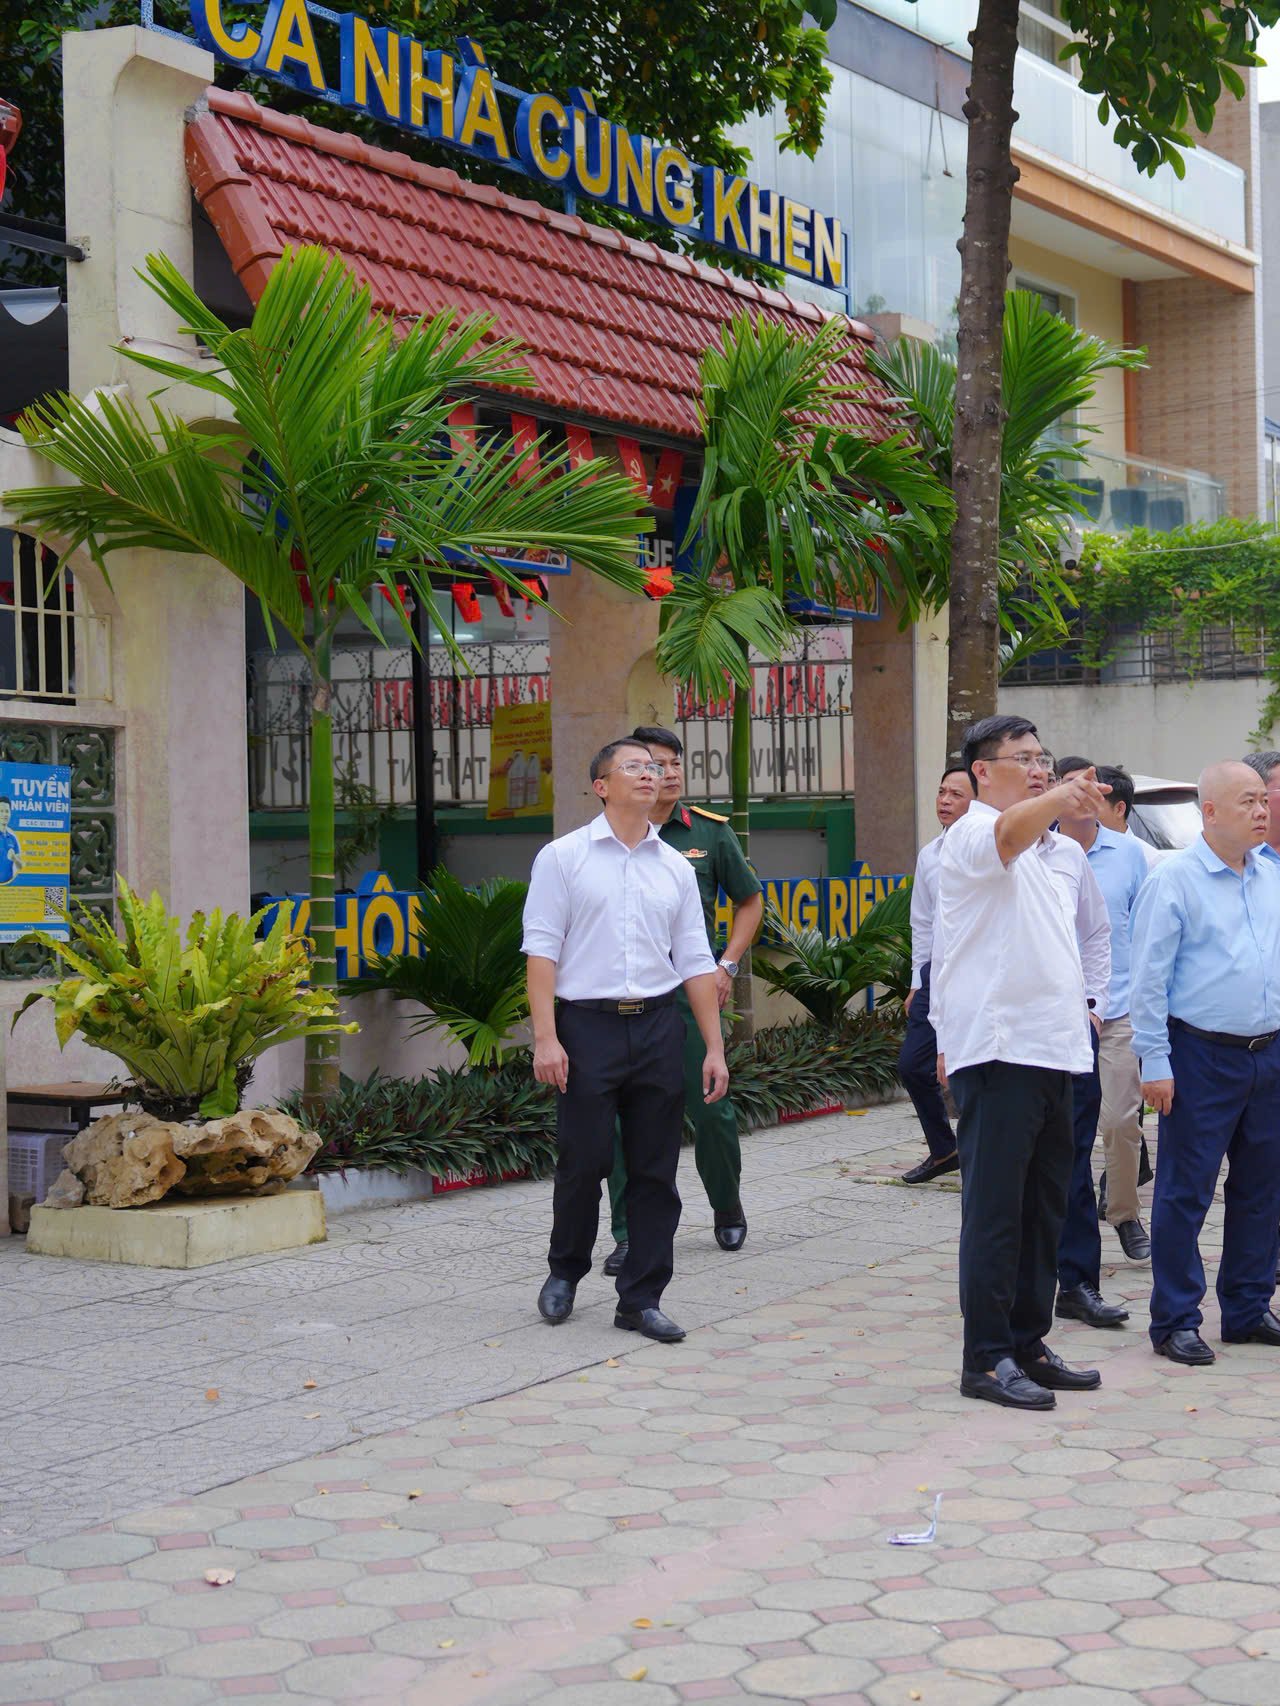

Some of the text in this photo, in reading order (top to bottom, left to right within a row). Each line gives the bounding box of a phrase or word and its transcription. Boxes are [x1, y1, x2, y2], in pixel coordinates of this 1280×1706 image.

[350, 18, 510, 161] NHÀ
[527, 88, 695, 229] CÙNG
[713, 171, 843, 286] KHEN
[11, 774, 69, 798] TUYỂN
[11, 798, 69, 813] NHÂN VIÊN
